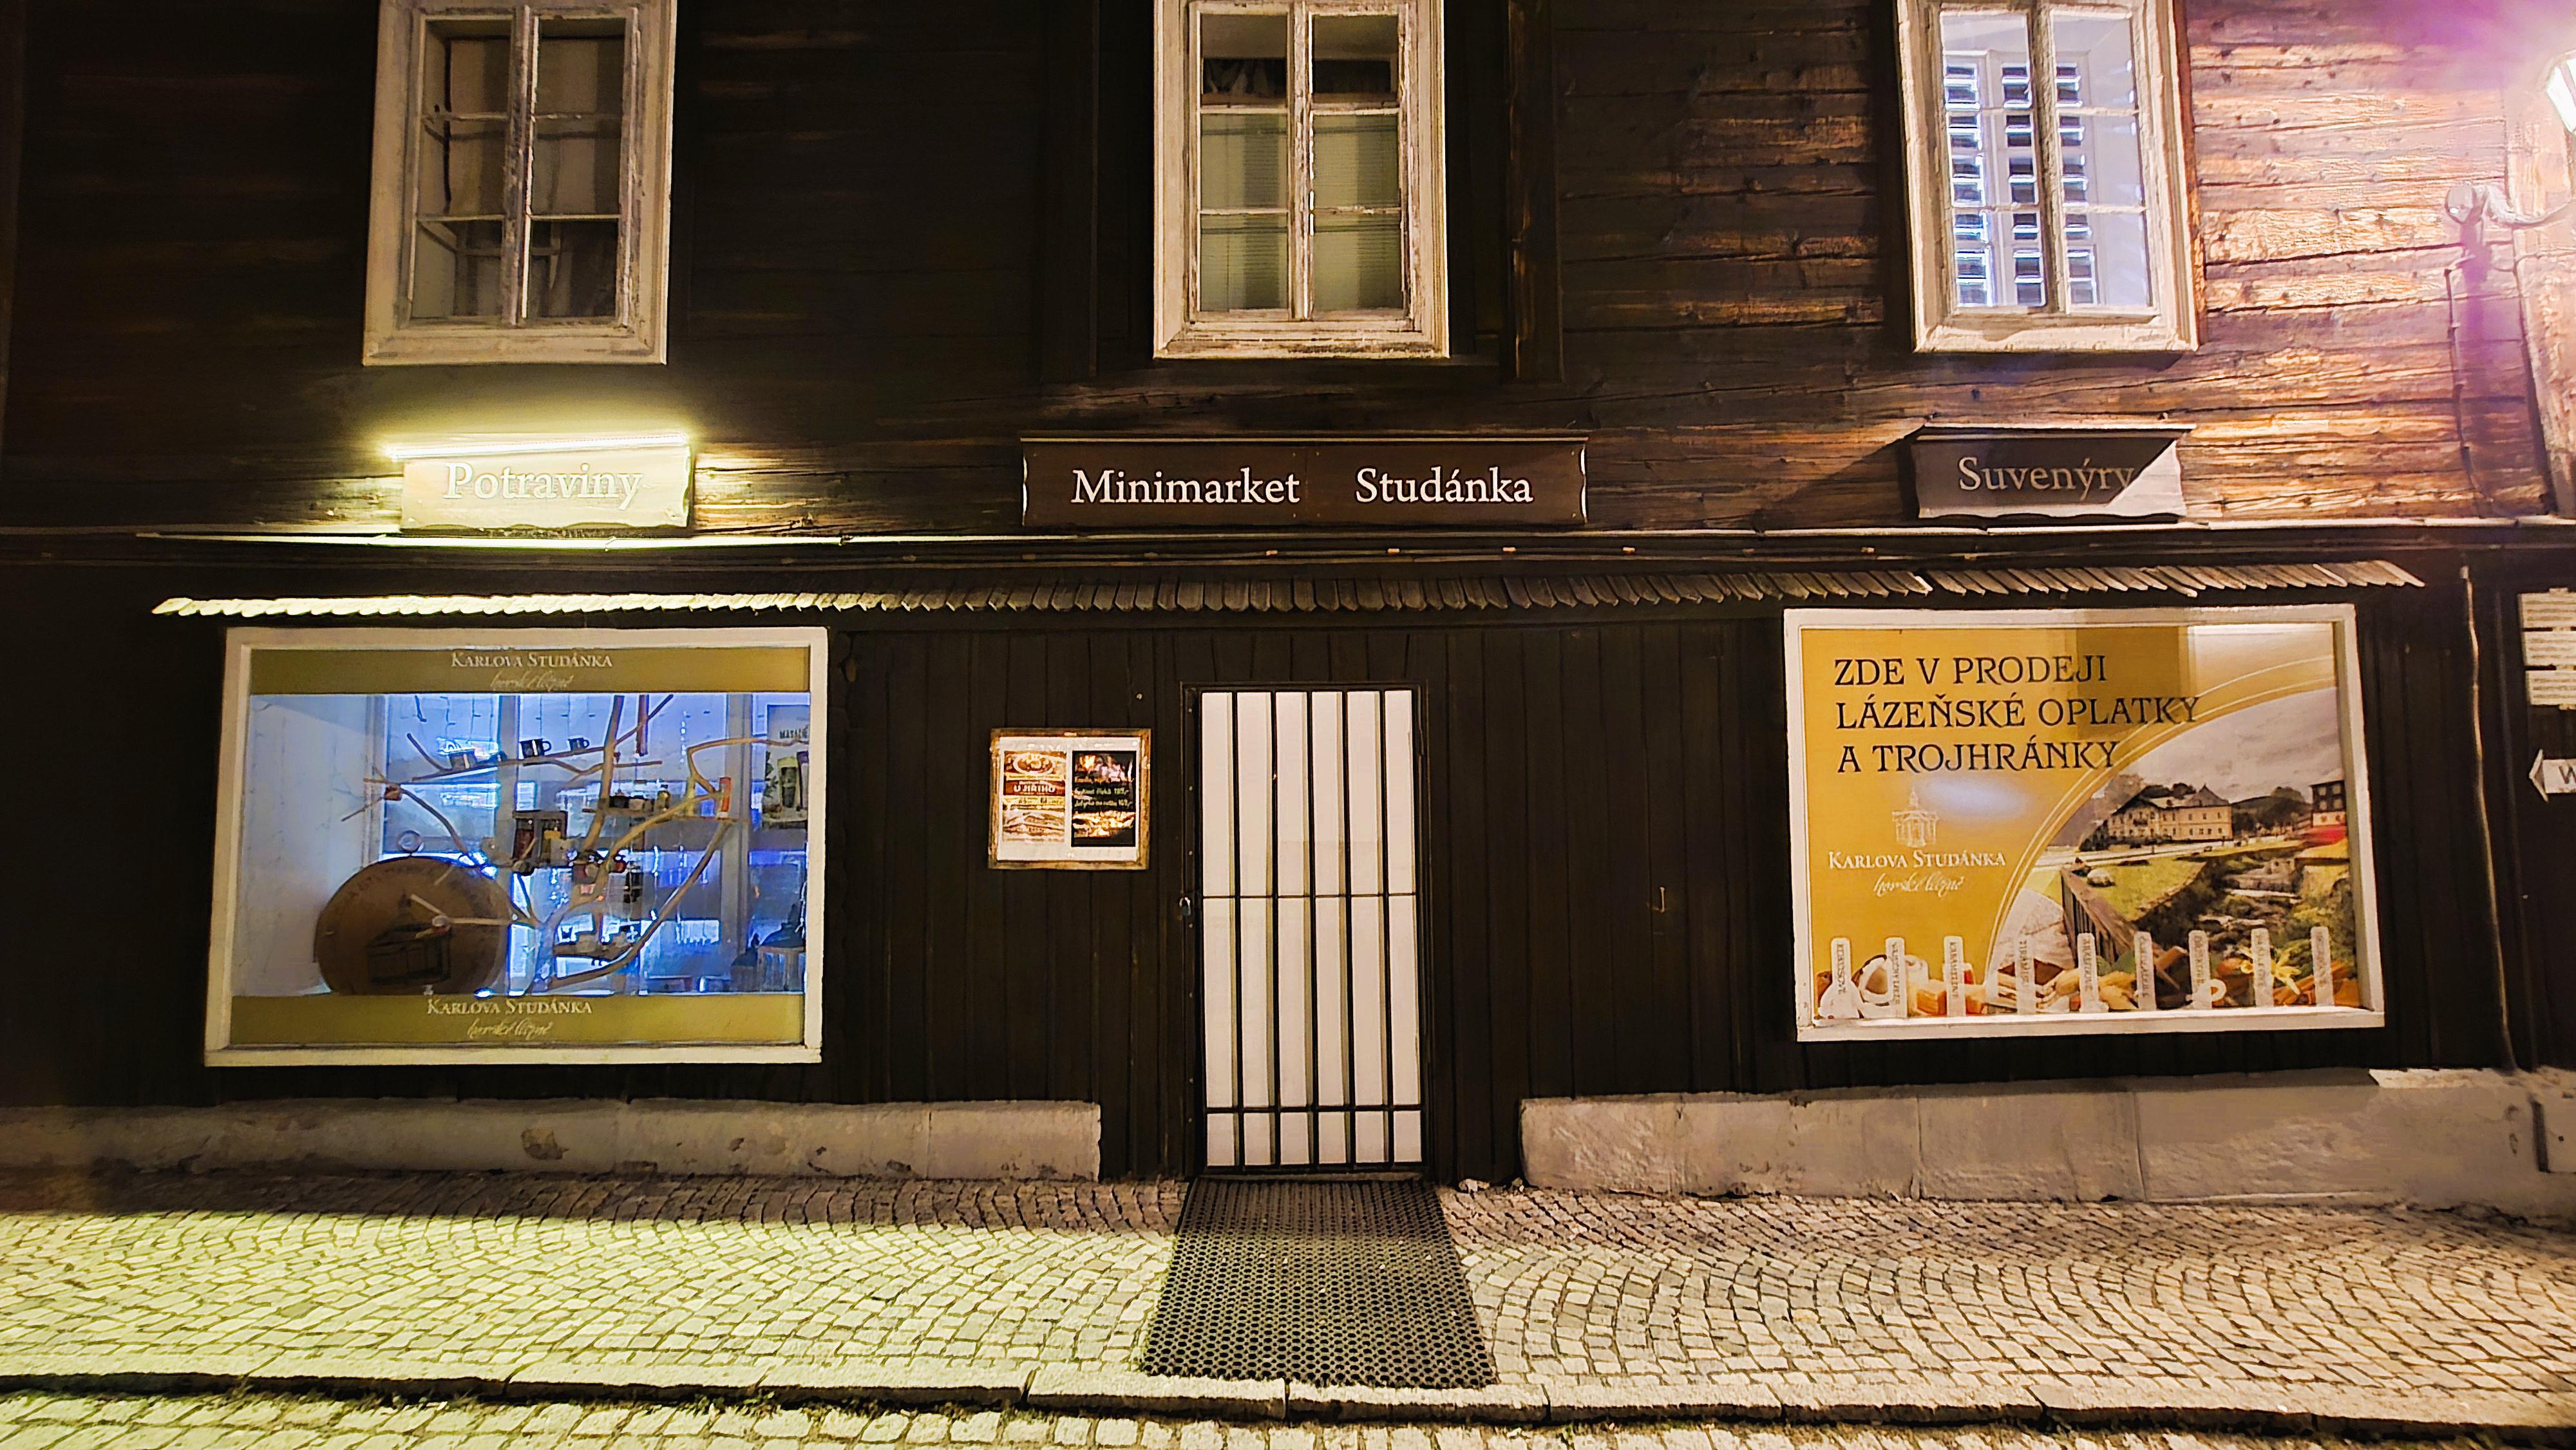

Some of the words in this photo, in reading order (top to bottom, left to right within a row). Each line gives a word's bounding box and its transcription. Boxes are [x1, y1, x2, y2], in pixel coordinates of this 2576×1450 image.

[443, 462, 642, 510] Potraviny
[1072, 467, 1300, 503] Minimarket
[1356, 467, 1533, 502] Studánka
[1958, 456, 2136, 501] Suvenýry
[451, 652, 523, 668] KARLOVA
[527, 652, 612, 668] STUDÁNKA
[1834, 658, 1904, 686] ZDE
[1915, 657, 1940, 684] V
[1953, 655, 2107, 685] PRODEJI
[1836, 692, 2025, 729] LÁZEŇSKÉ
[2038, 697, 2199, 727] OPLATKY
[1837, 746, 1862, 773] A
[1871, 735, 2121, 773] TROJHRÁNKY
[1828, 851, 1908, 869] KARLOVA
[1913, 849, 2005, 868] STUDÁNKA
[427, 998, 500, 1015] KARLOVA
[506, 997, 592, 1015] STUDÁNKA
